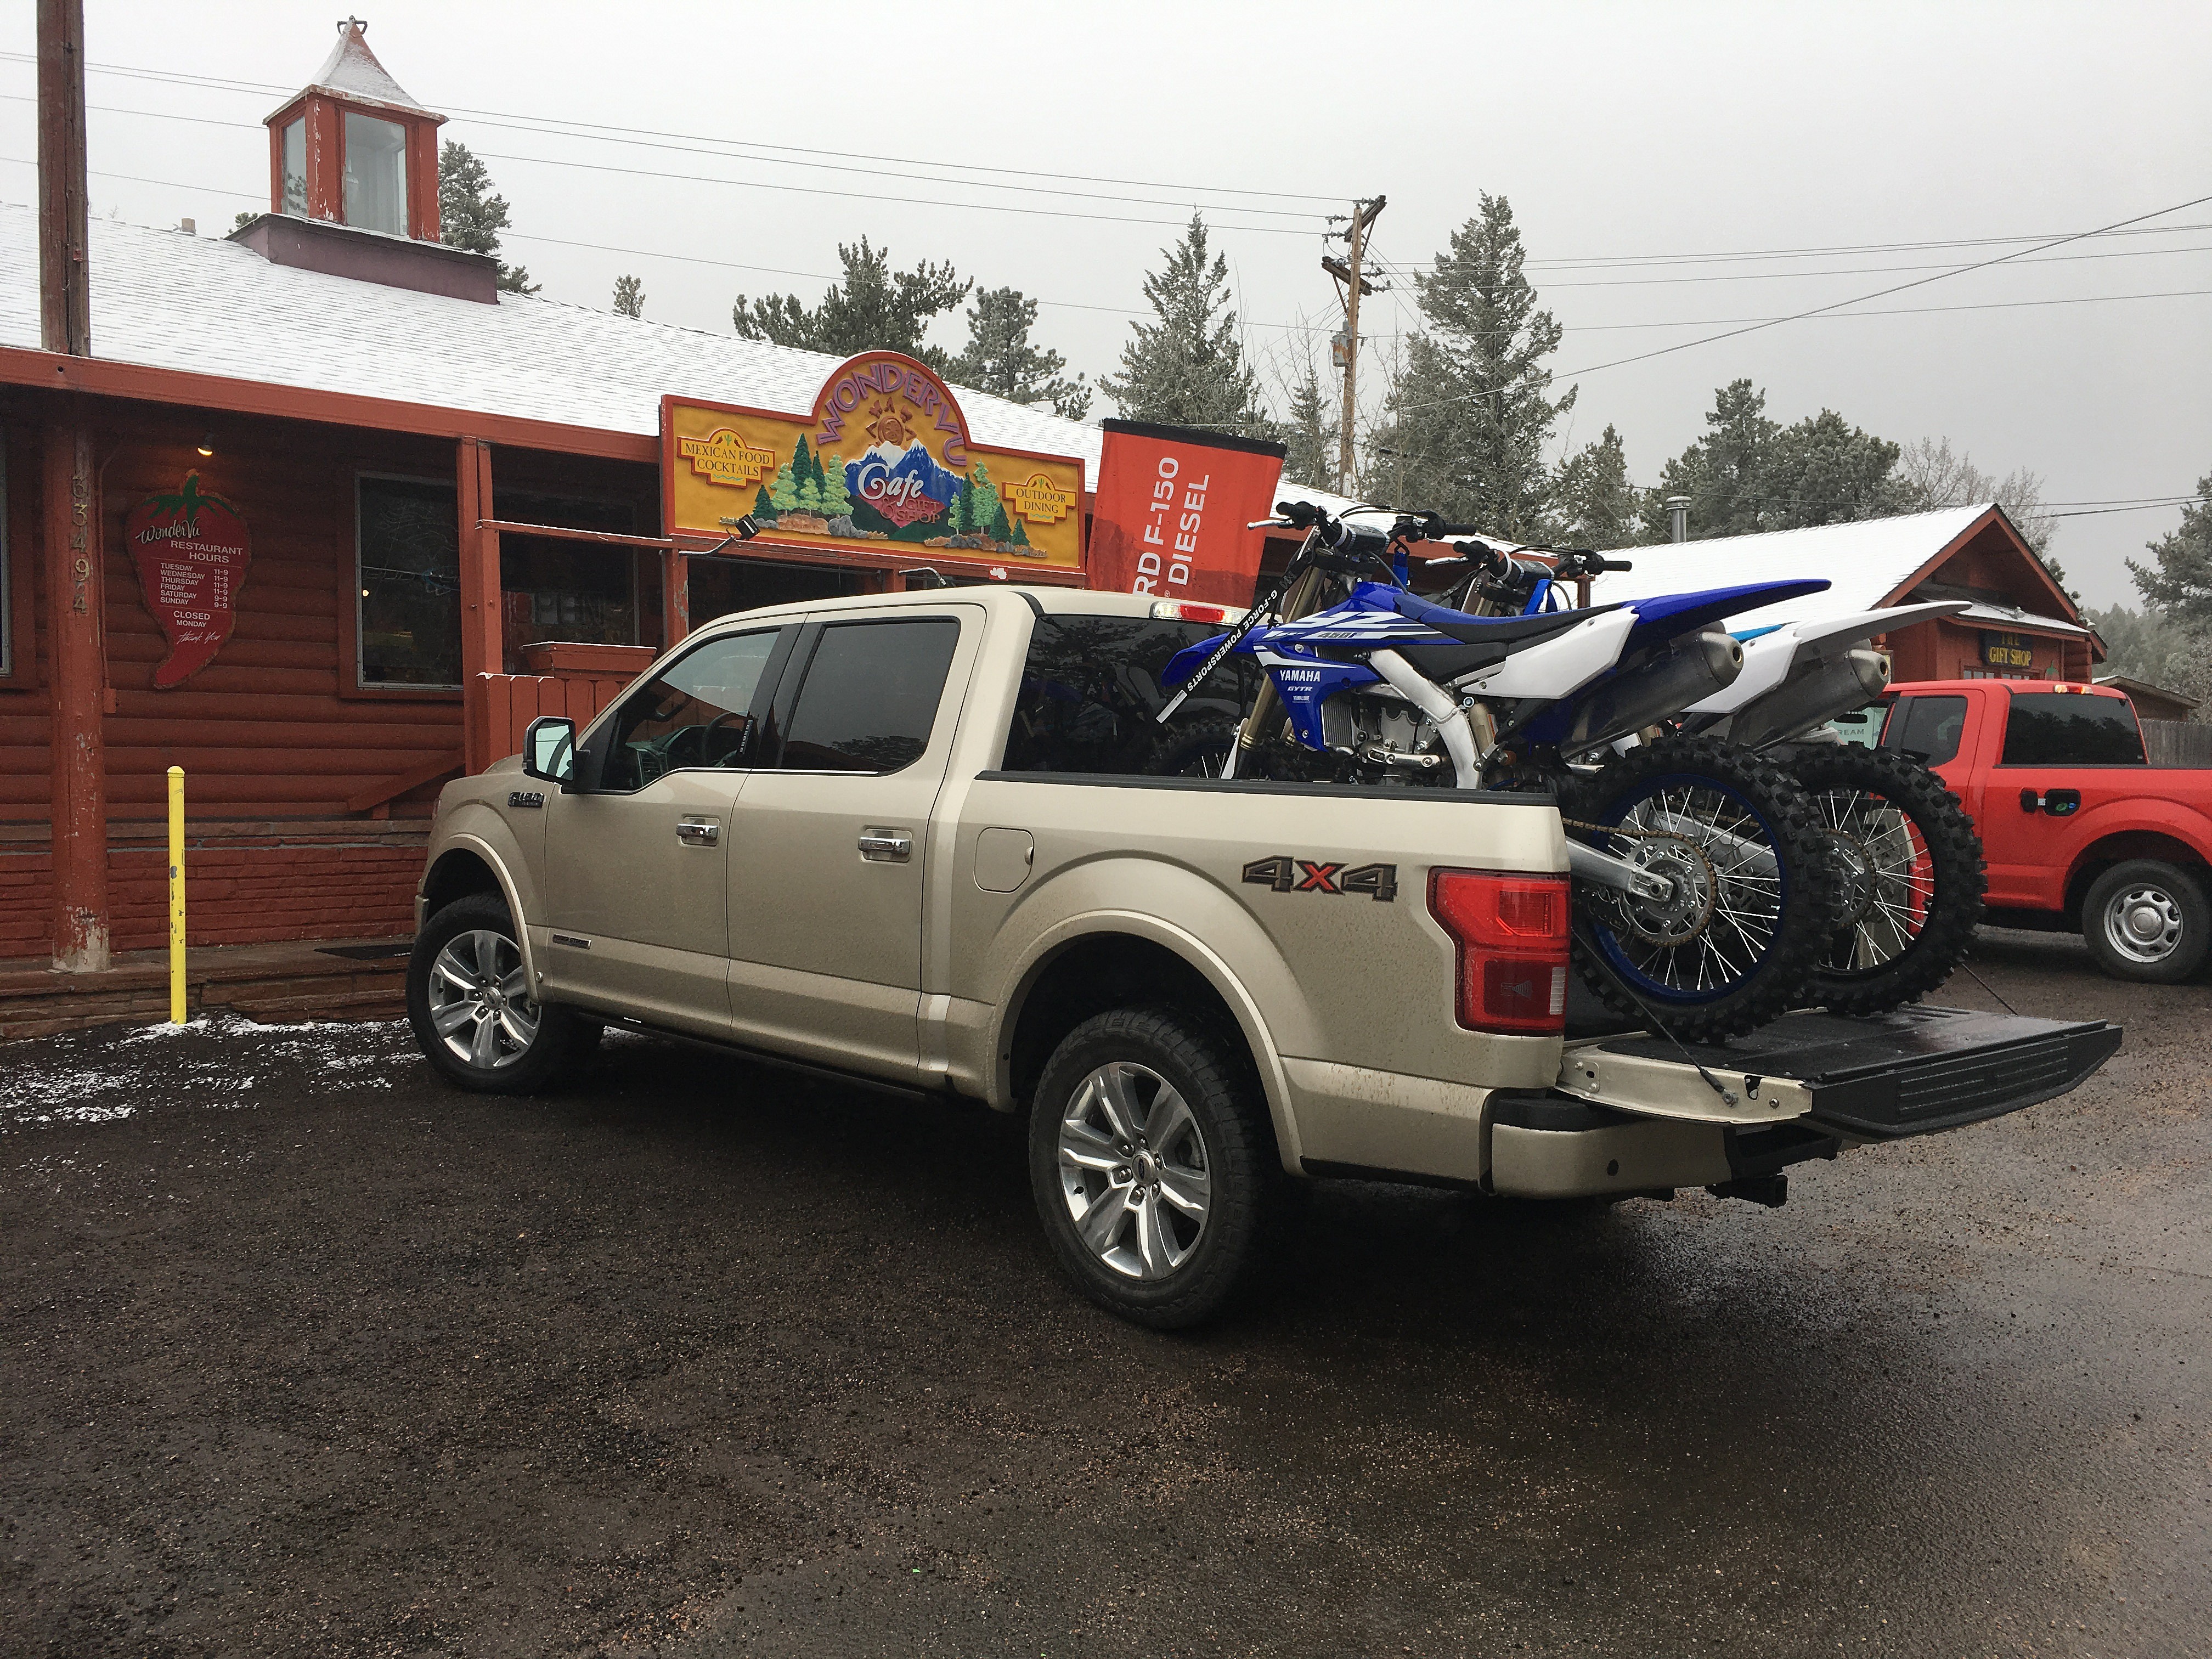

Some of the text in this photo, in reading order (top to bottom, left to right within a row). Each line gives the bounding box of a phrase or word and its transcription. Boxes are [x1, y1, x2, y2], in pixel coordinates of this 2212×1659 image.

[685, 443, 770, 465] MEXICAN FOOD
[697, 458, 759, 477] COCKTAILS
[857, 462, 924, 507] Cafe
[1016, 488, 1066, 503] OUTDOOR
[1144, 457, 1179, 545] F-150
[905, 499, 940, 511] GIFT
[1024, 500, 1058, 514] DINING
[896, 510, 941, 524] SHOP
[1167, 475, 1210, 585] DIESEL
[171, 540, 243, 555] RESTAURANT
[189, 552, 229, 563] HOURS
[160, 562, 194, 571] TUESDAY
[160, 569, 205, 579] WEDNESDAY
[161, 576, 199, 585] THURSDAY
[160, 583, 185, 591] FRIDAY
[160, 590, 198, 599] SATURDAY
[160, 596, 189, 605] SUNDAY
[173, 610, 210, 620] CLOSED
[176, 619, 207, 628] MONDAY
[1187, 590, 1277, 691] G-FORCE POWERSPORTS
[1988, 646, 2032, 667] GIFT SHOP
[1280, 670, 1321, 682] YAMAHA
